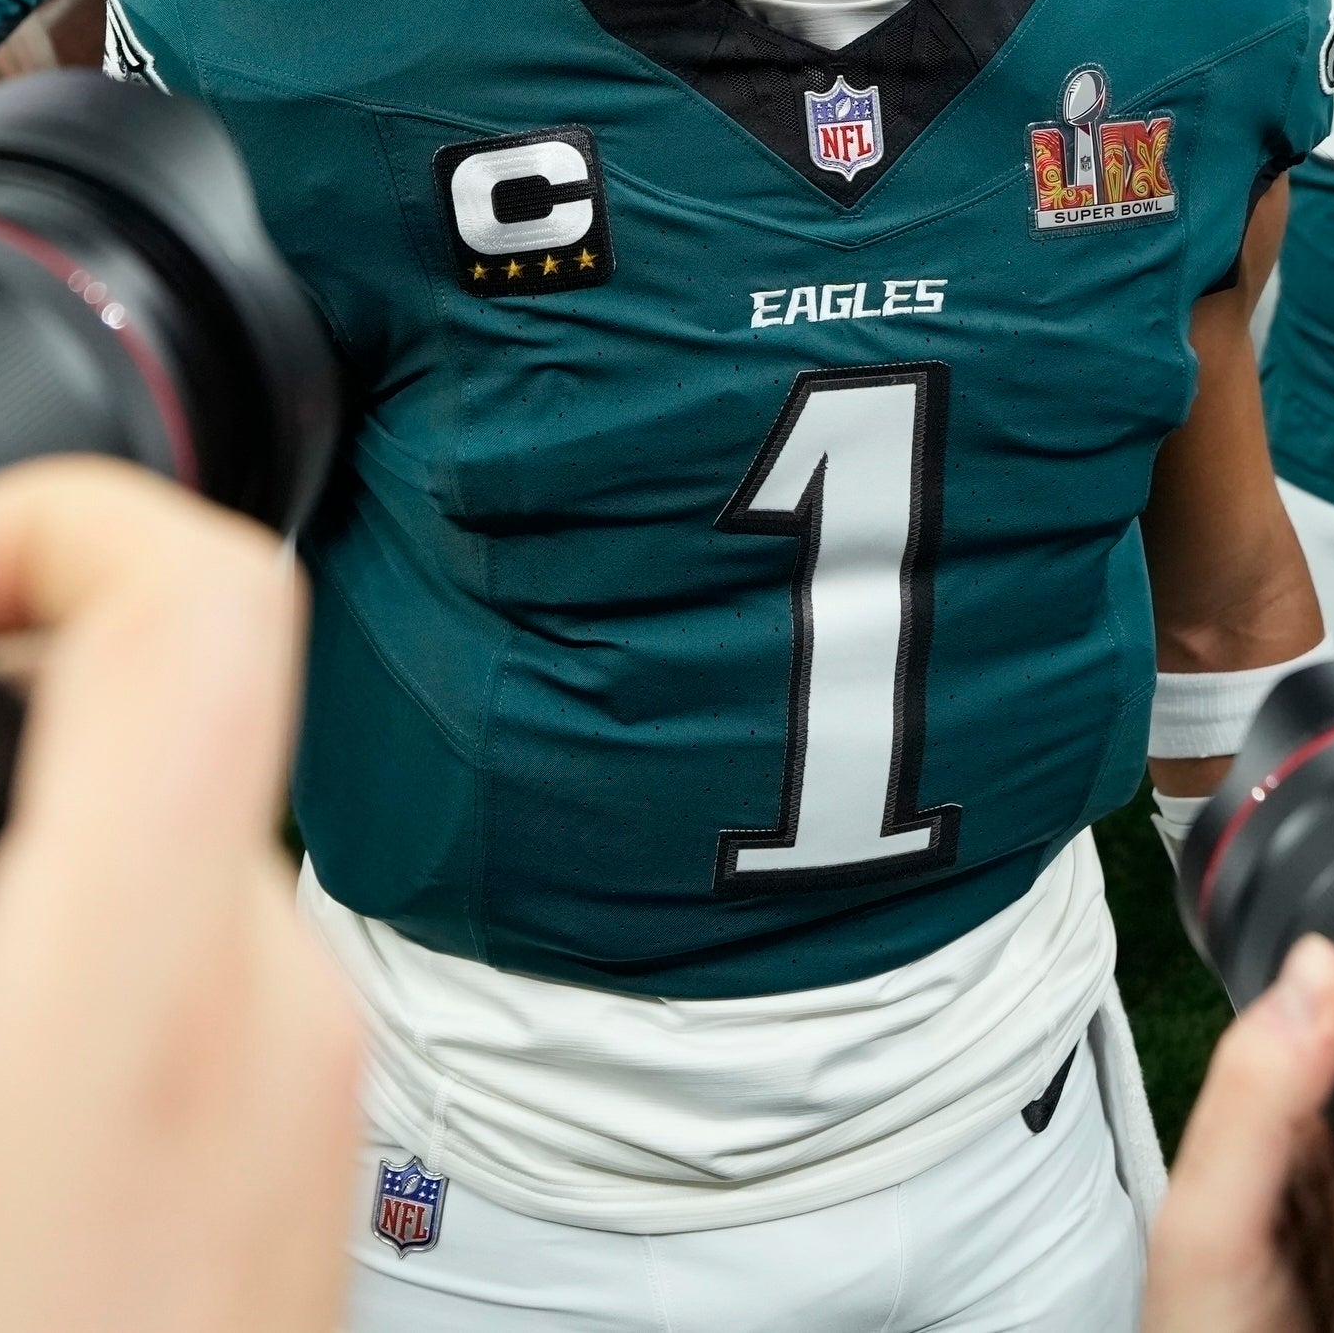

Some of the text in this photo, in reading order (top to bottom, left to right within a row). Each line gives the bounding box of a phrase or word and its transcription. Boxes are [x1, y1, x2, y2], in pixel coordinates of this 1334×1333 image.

[820, 123, 874, 163] NFL
[1031, 117, 1174, 211] LIX
[450, 140, 595, 256] C
[1054, 199, 1163, 225] SUPER BOWL
[749, 279, 949, 329] EAGLES
[714, 359, 963, 892] 1
[381, 1198, 428, 1242] NFL
